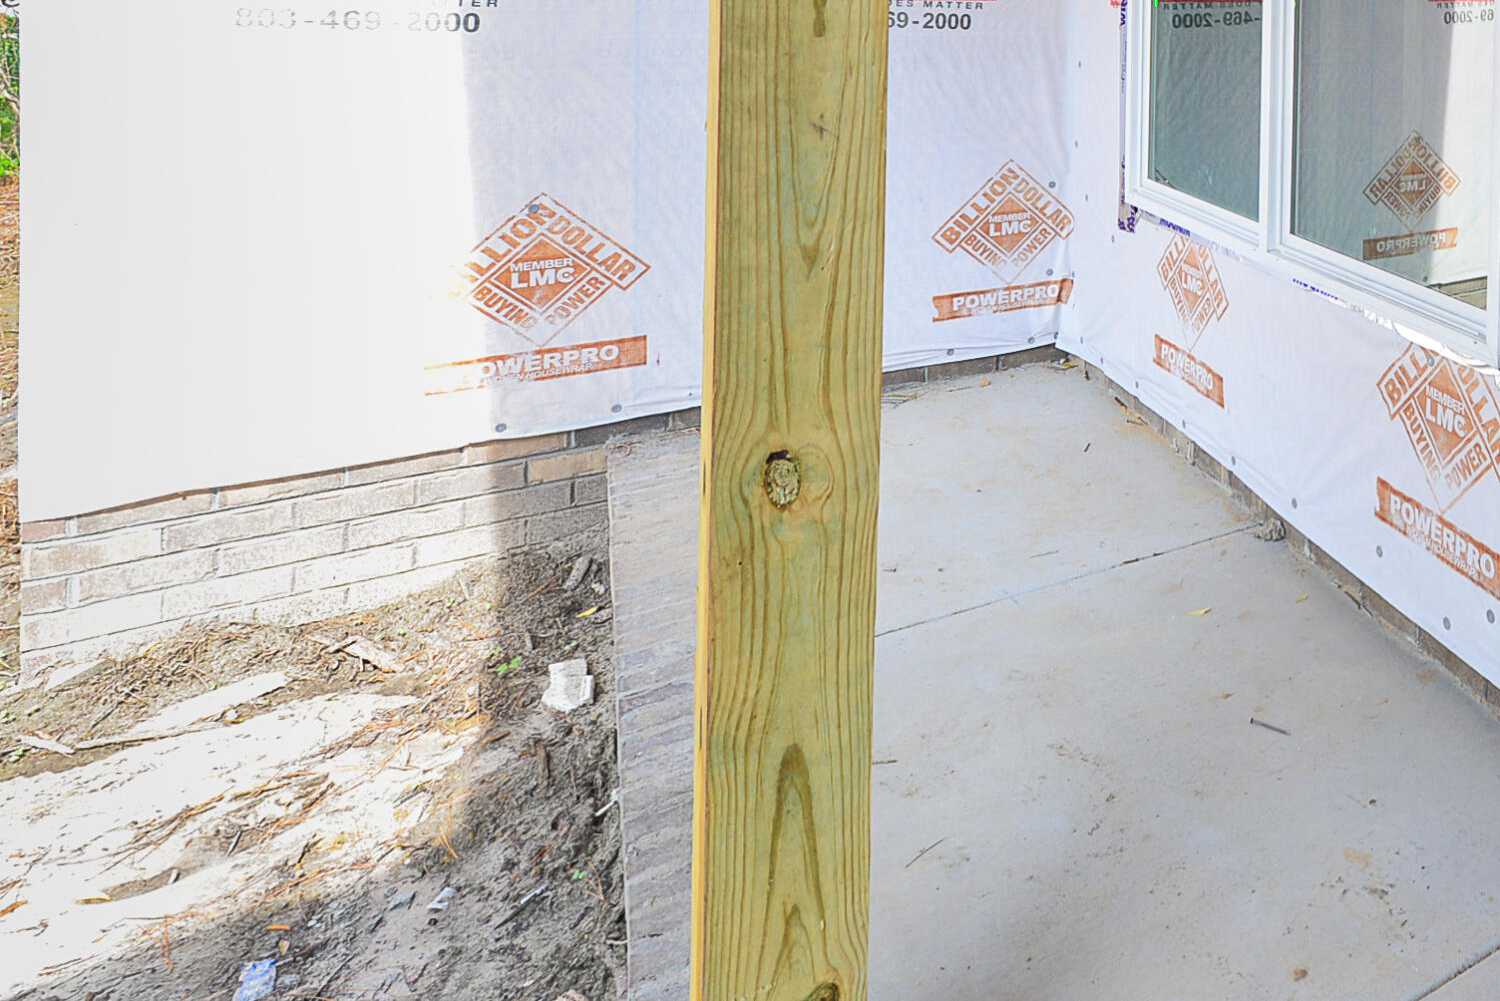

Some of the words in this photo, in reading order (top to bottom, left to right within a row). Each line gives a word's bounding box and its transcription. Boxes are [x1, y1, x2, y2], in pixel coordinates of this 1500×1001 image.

[923, 0, 983, 10] MATTER
[941, 168, 1021, 246] BILLION
[1012, 180, 1072, 233] DOLLAR
[988, 221, 1032, 237] LMC
[1012, 226, 1052, 267] POWER
[510, 257, 573, 273] MEMBER
[548, 217, 636, 283] DOLLAR
[510, 267, 577, 289] LMC
[473, 285, 538, 331] BUYING
[545, 275, 607, 326] POWER
[953, 284, 1060, 311] POWERPRO
[477, 344, 620, 378] OWERPRO
[1425, 385, 1467, 416] MEMBER
[1425, 400, 1468, 439] LMC
[1403, 404, 1441, 482] BUYING
[1444, 441, 1486, 489] POWER
[1390, 493, 1496, 580] POWERPRO
